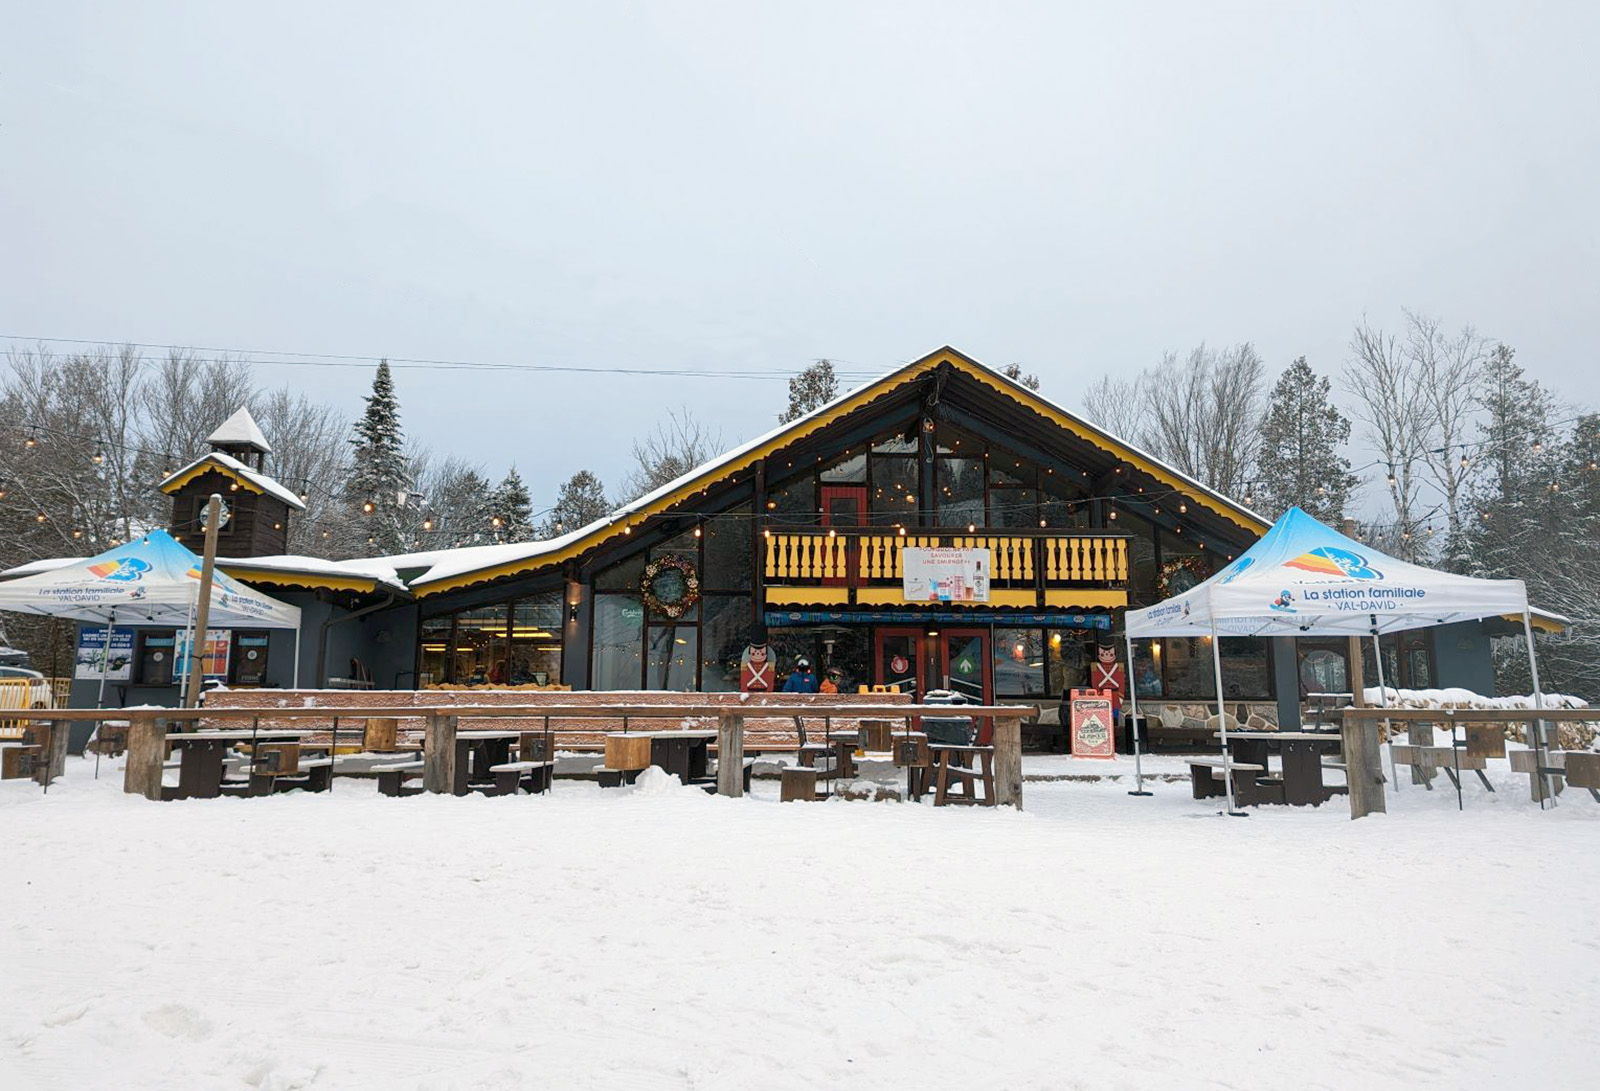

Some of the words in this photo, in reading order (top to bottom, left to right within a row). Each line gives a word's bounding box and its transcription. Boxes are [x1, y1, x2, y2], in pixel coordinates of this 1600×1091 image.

[52, 587, 83, 595] station
[85, 587, 125, 595] familiale
[1303, 589, 1319, 600] La
[1322, 587, 1365, 600] station
[1368, 586, 1426, 599] familiale
[57, 594, 101, 602] VAL-DAVID
[1335, 600, 1397, 611] VAL-DAVID
